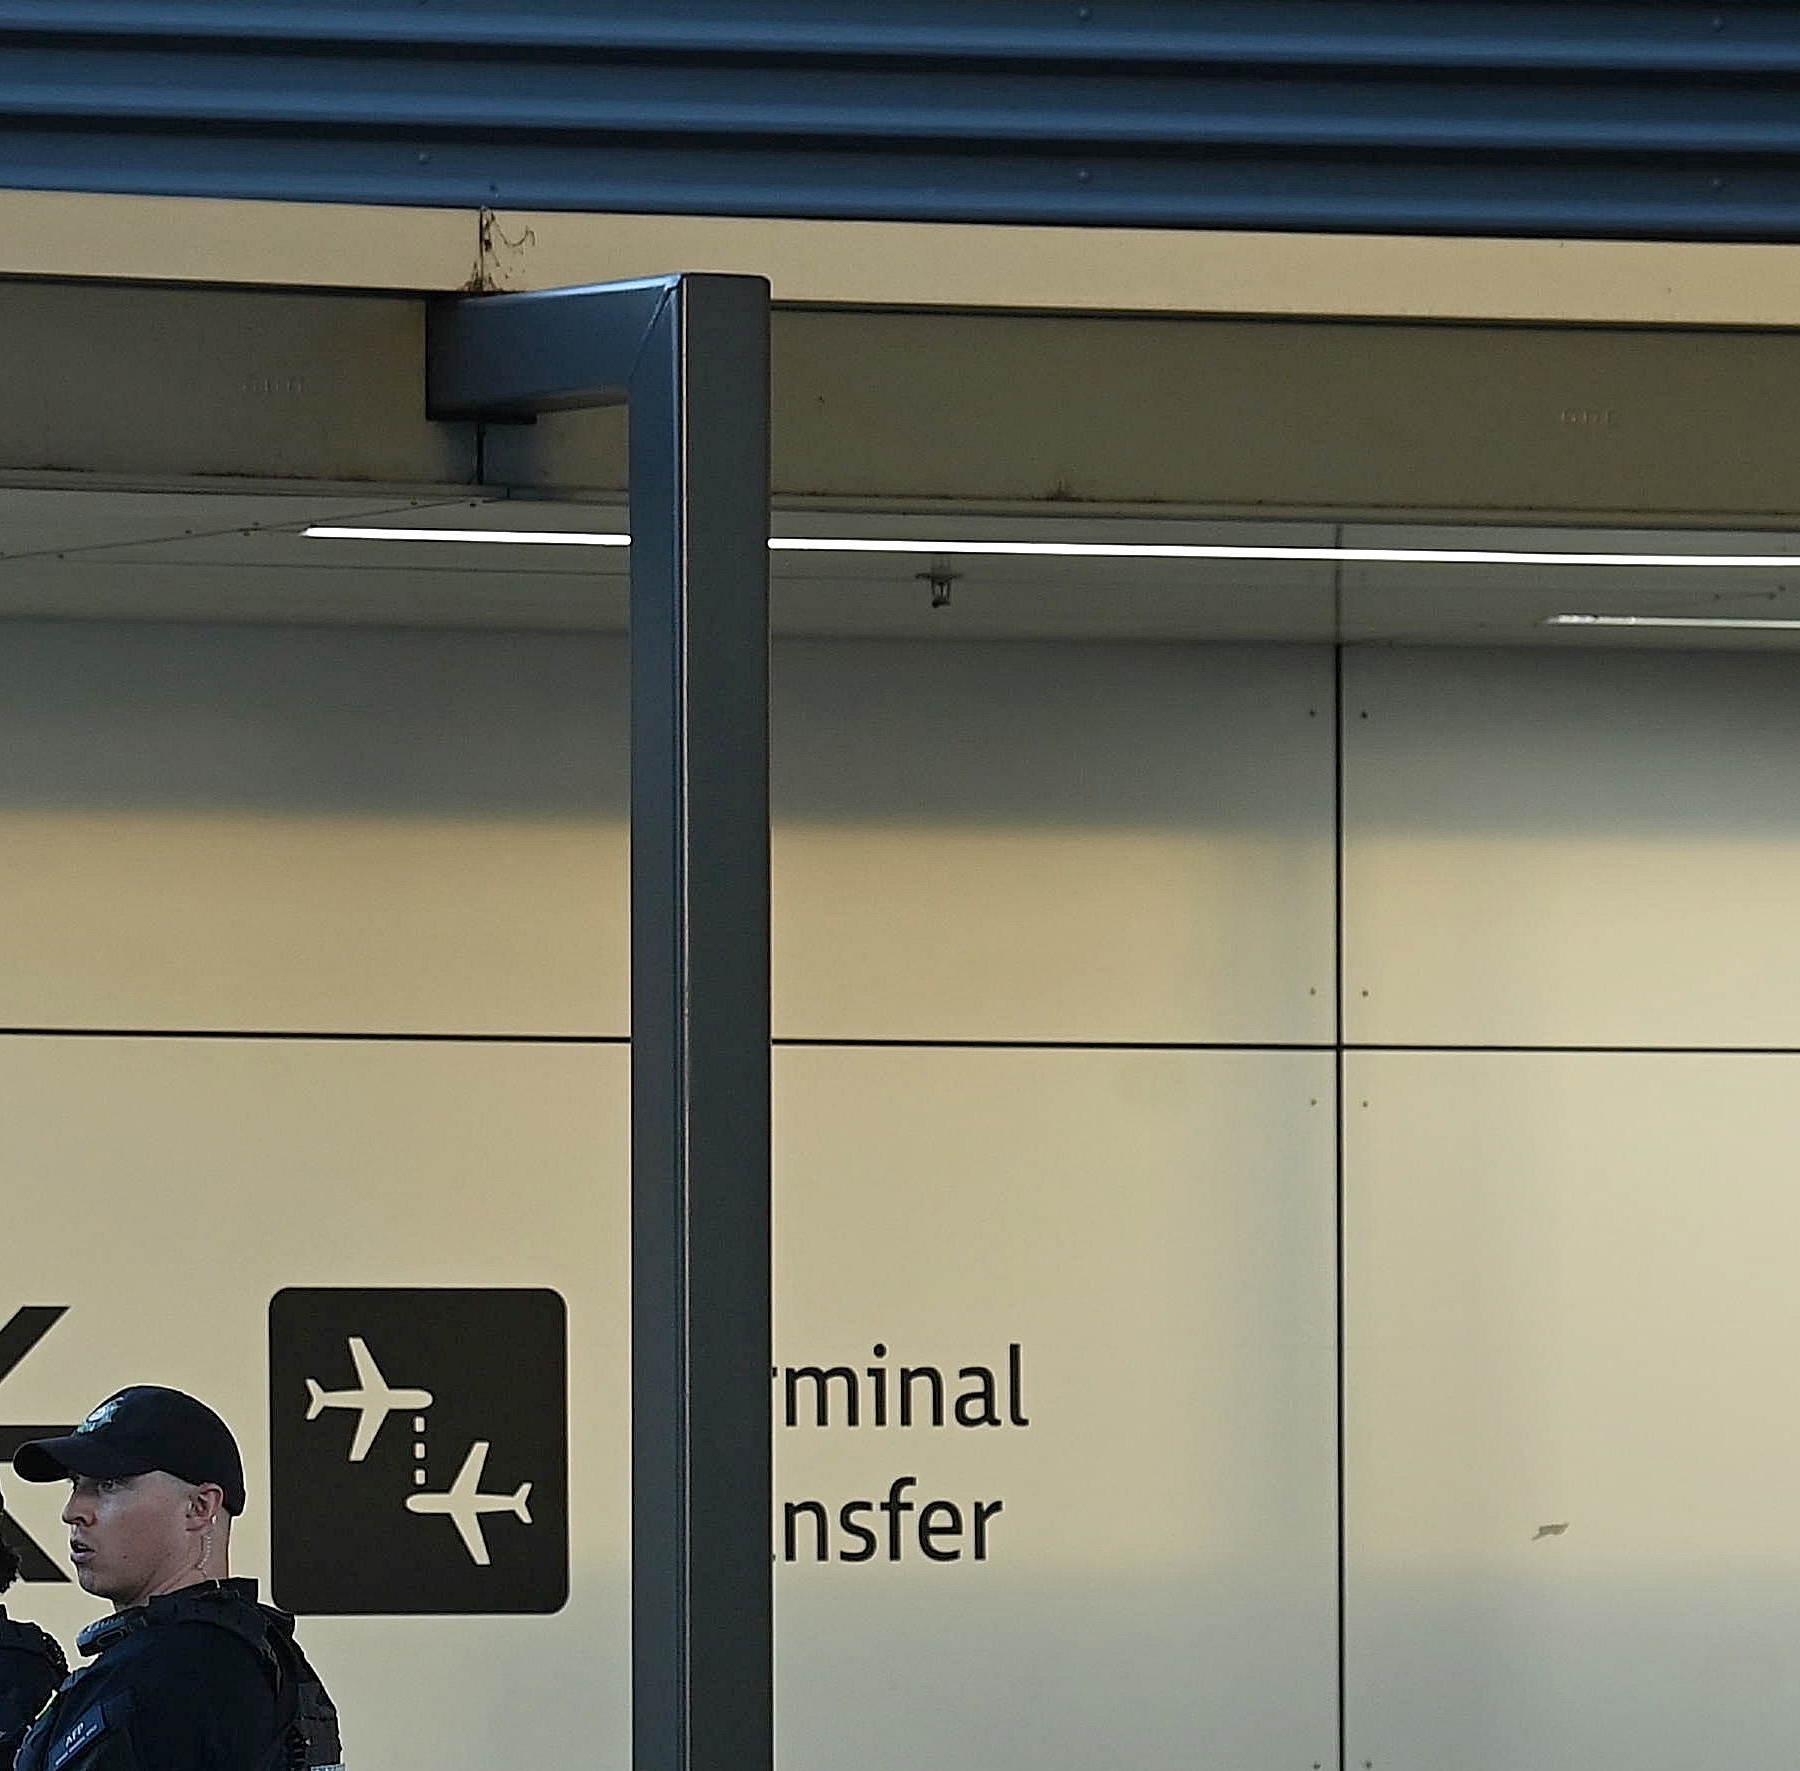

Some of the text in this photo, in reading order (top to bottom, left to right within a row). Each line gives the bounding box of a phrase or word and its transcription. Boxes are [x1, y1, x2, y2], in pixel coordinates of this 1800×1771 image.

[771, 1343, 1030, 1427] minal
[772, 1476, 1004, 1562] nsfer
[65, 1722, 85, 1748] AFP
